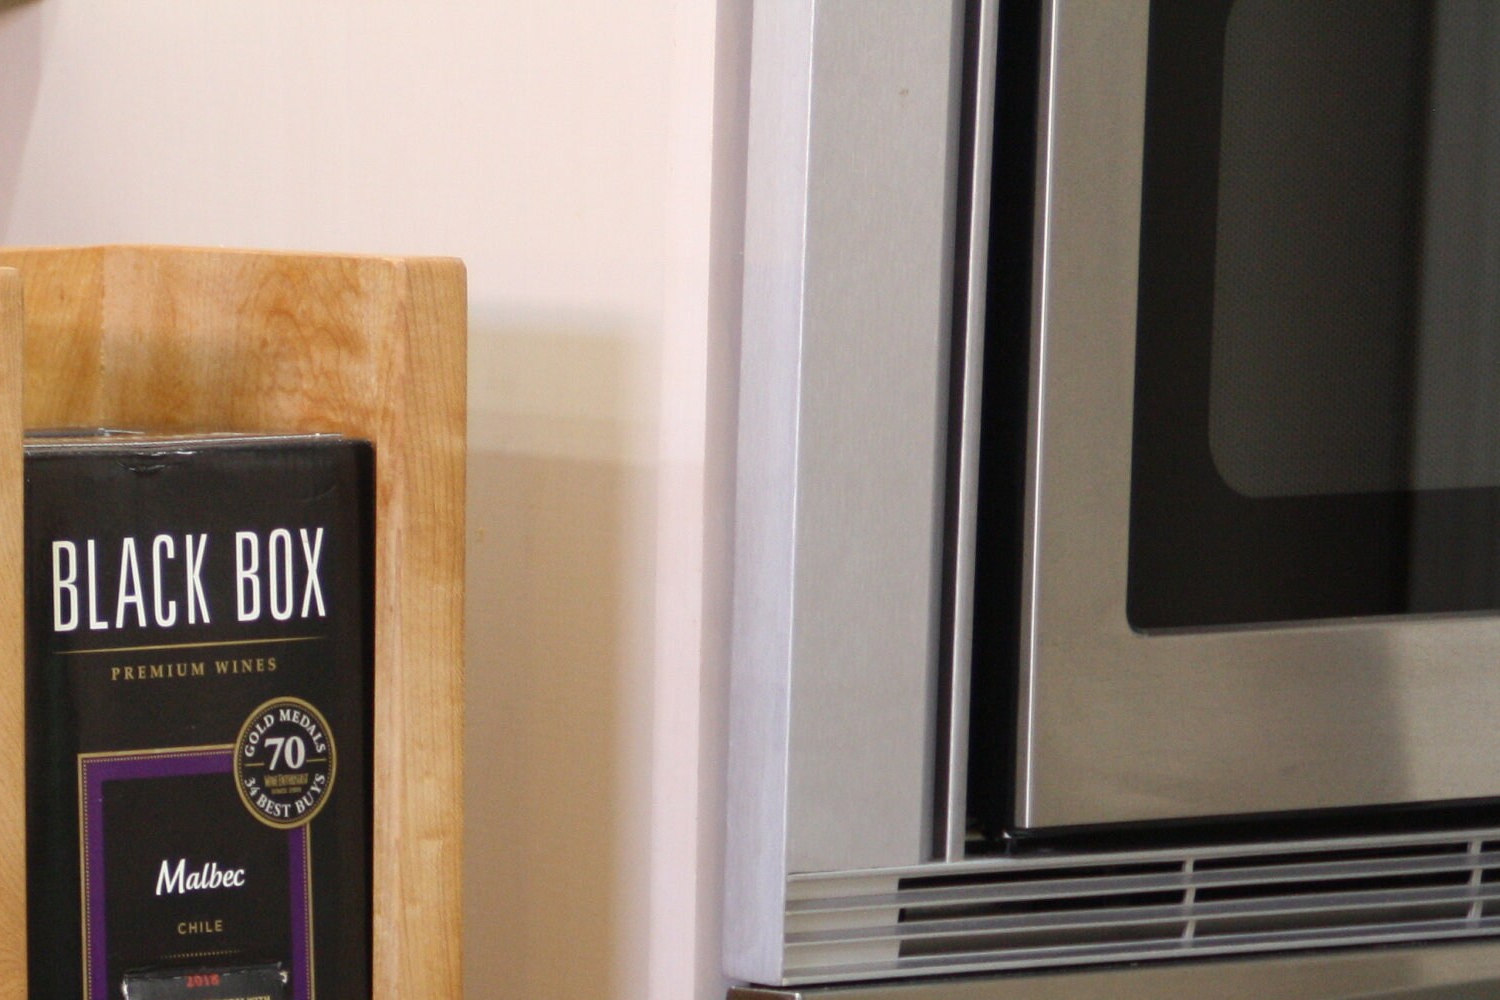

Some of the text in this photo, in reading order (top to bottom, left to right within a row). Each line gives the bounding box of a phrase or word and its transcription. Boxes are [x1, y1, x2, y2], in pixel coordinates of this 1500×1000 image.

[51, 527, 326, 632] BLACK BOX
[111, 657, 278, 681] PREMIUM WINES
[244, 708, 326, 758] GOLD MEDALS
[263, 736, 306, 771] 70
[244, 773, 326, 818] 34 BEST BUYS
[156, 858, 246, 896] Malbec
[177, 920, 224, 935] CHILE
